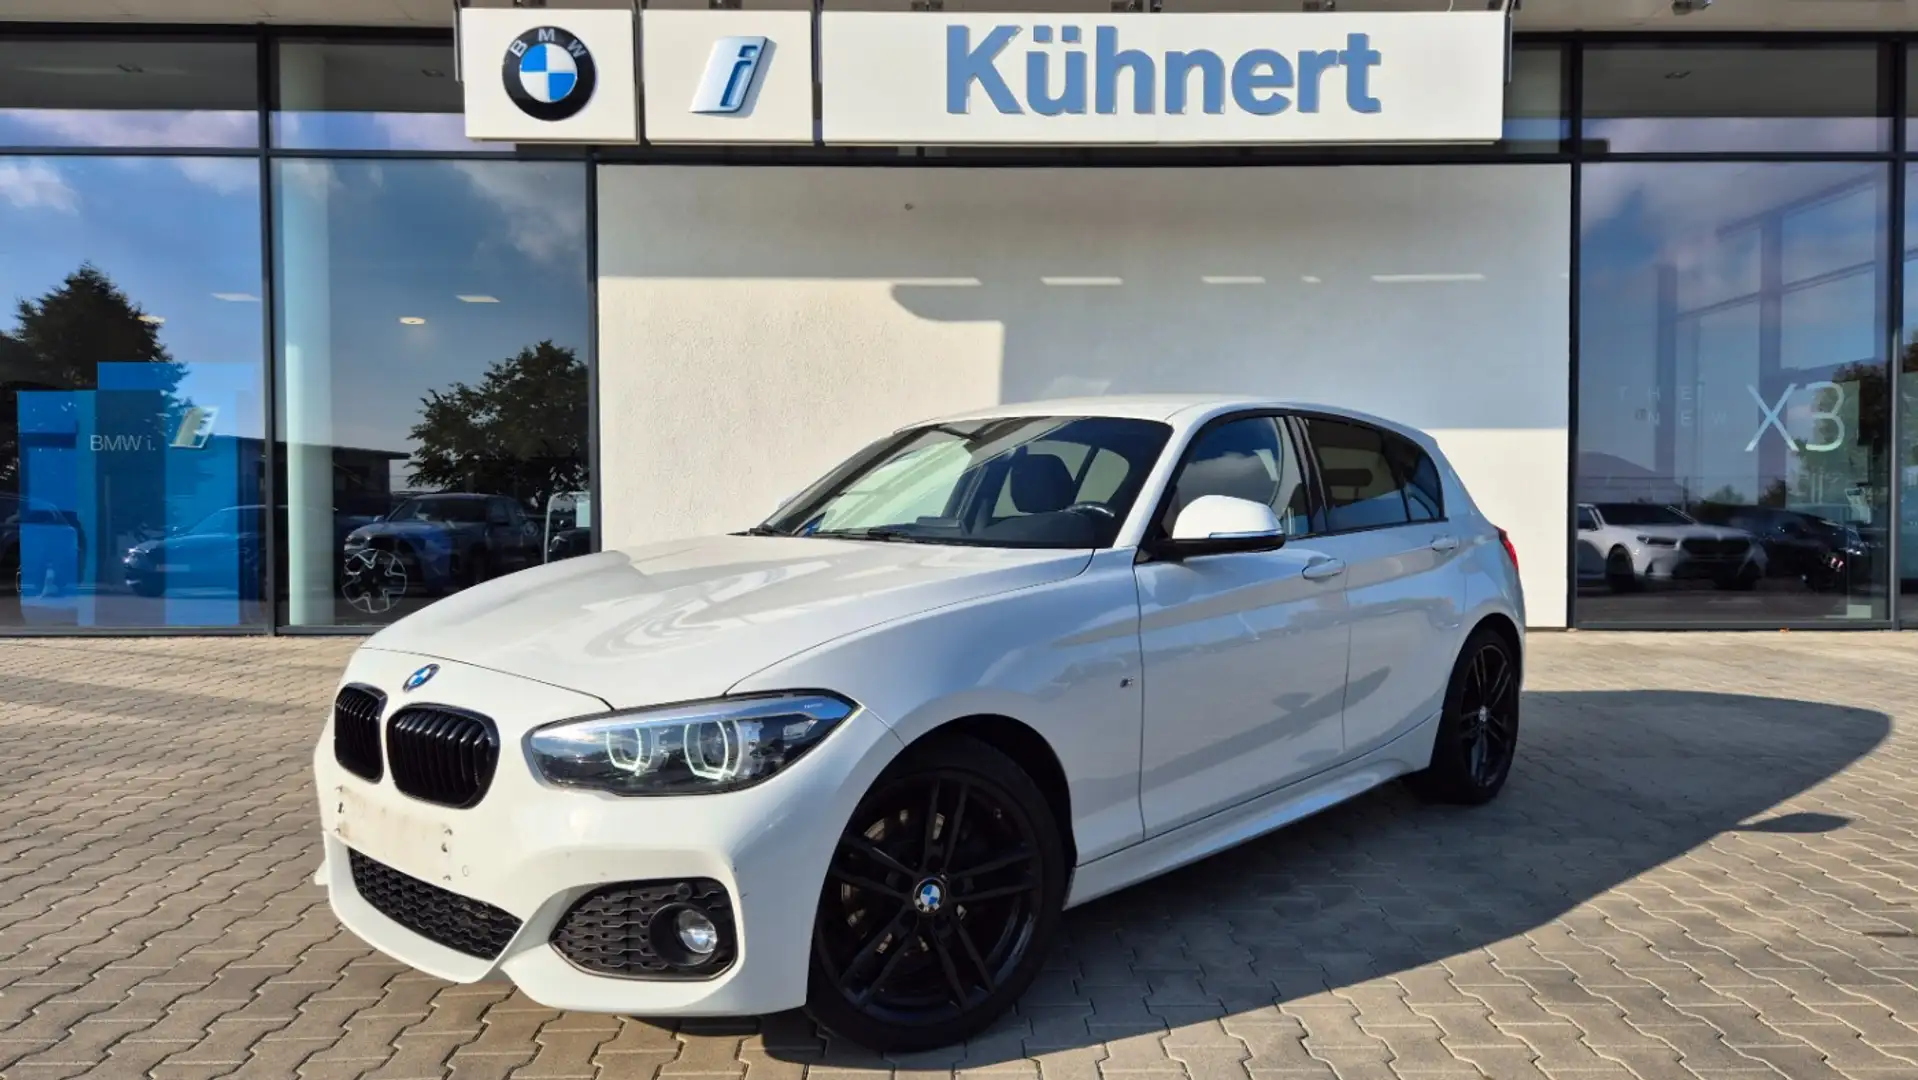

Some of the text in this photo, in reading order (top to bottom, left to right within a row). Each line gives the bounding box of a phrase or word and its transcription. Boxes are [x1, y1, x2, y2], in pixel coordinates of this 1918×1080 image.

[509, 28, 587, 58] BMW
[946, 25, 1382, 115] Kühnert
[1617, 385, 1693, 401] THE
[1648, 409, 1727, 427] NEW
[1744, 380, 1845, 452] X3
[90, 434, 142, 451] BMW
